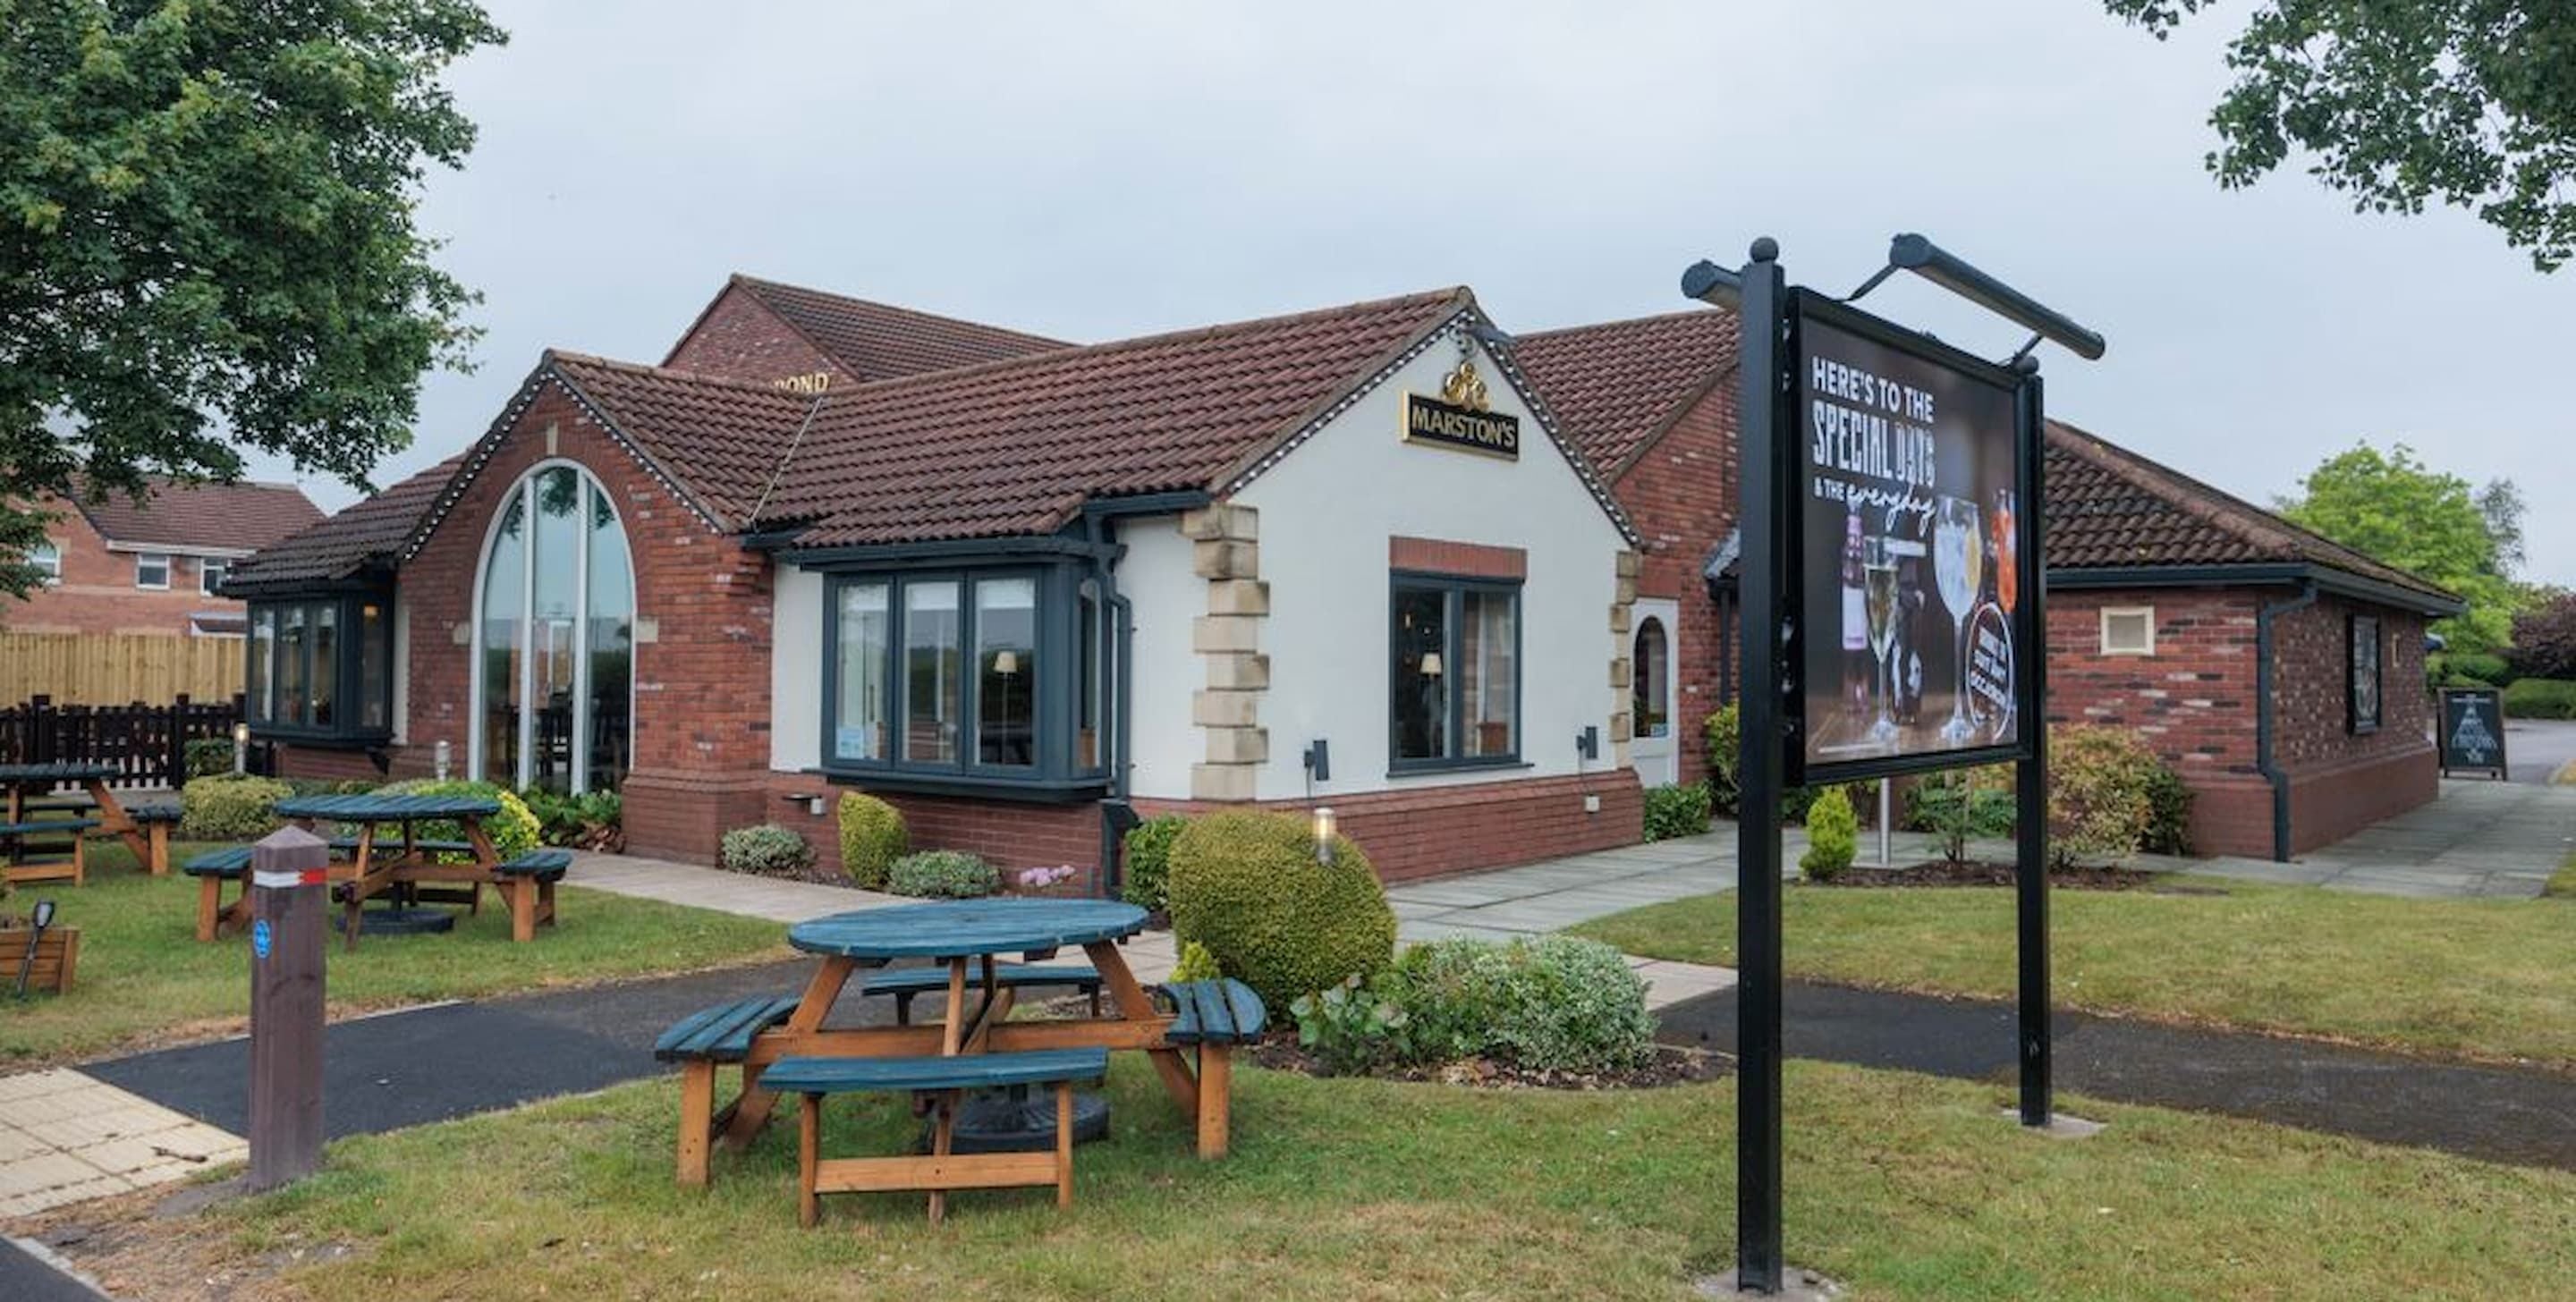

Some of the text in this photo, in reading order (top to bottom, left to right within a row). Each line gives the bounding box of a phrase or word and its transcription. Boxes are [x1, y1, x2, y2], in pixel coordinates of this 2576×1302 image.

[1812, 356, 1935, 424] HERE'S TO THE
[1411, 405, 1515, 448] MARSTON'S
[1812, 400, 1893, 479] SPECIAL
[1824, 478, 1845, 501] THE
[1846, 484, 1936, 537] everyday
